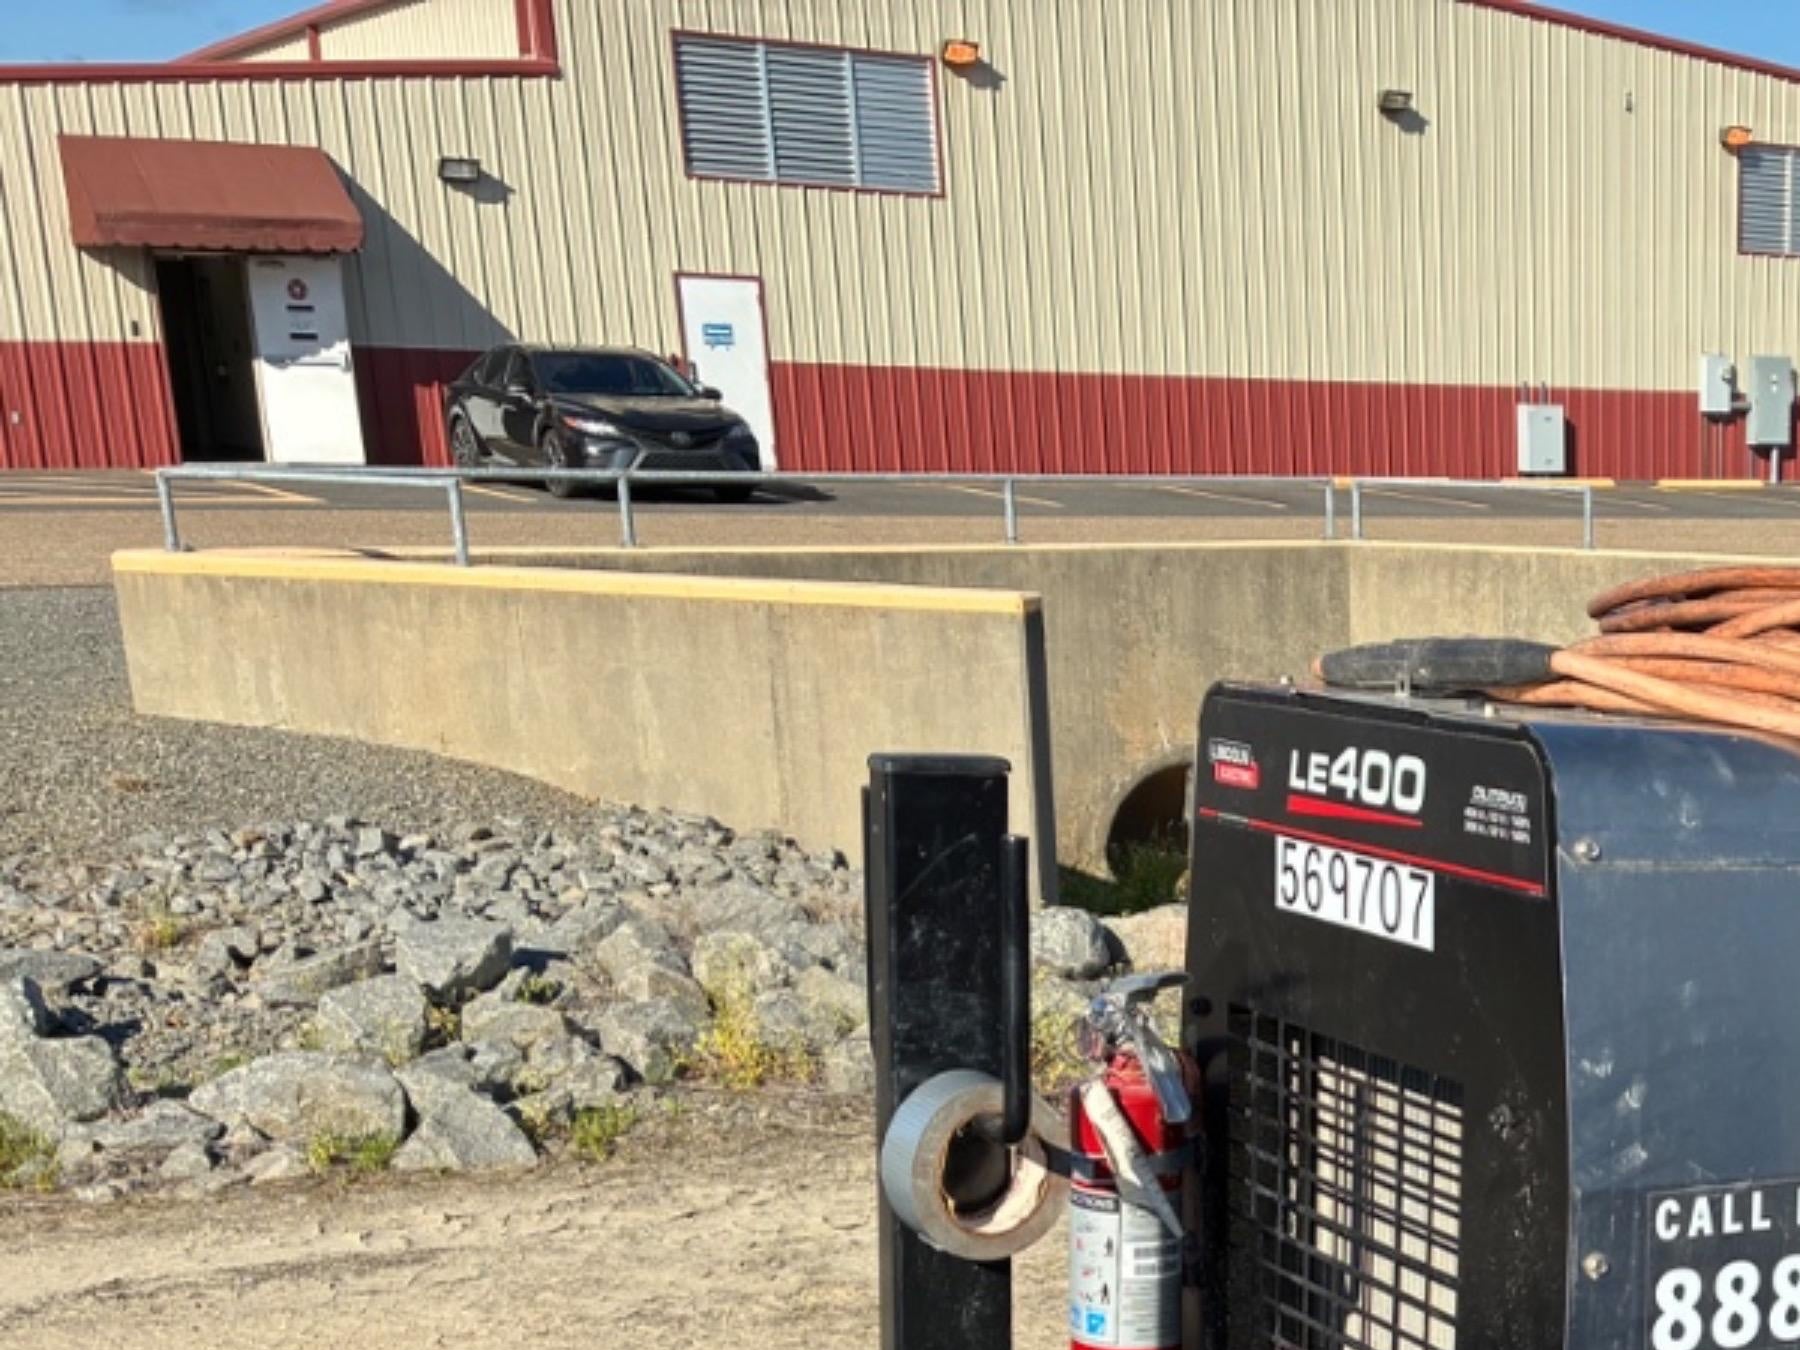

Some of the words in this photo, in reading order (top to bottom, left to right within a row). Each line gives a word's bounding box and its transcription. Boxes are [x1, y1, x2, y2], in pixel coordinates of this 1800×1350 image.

[1289, 746, 1427, 814] LE400
[1281, 841, 1430, 941] 569707
[1655, 1190, 1772, 1241] CALL
